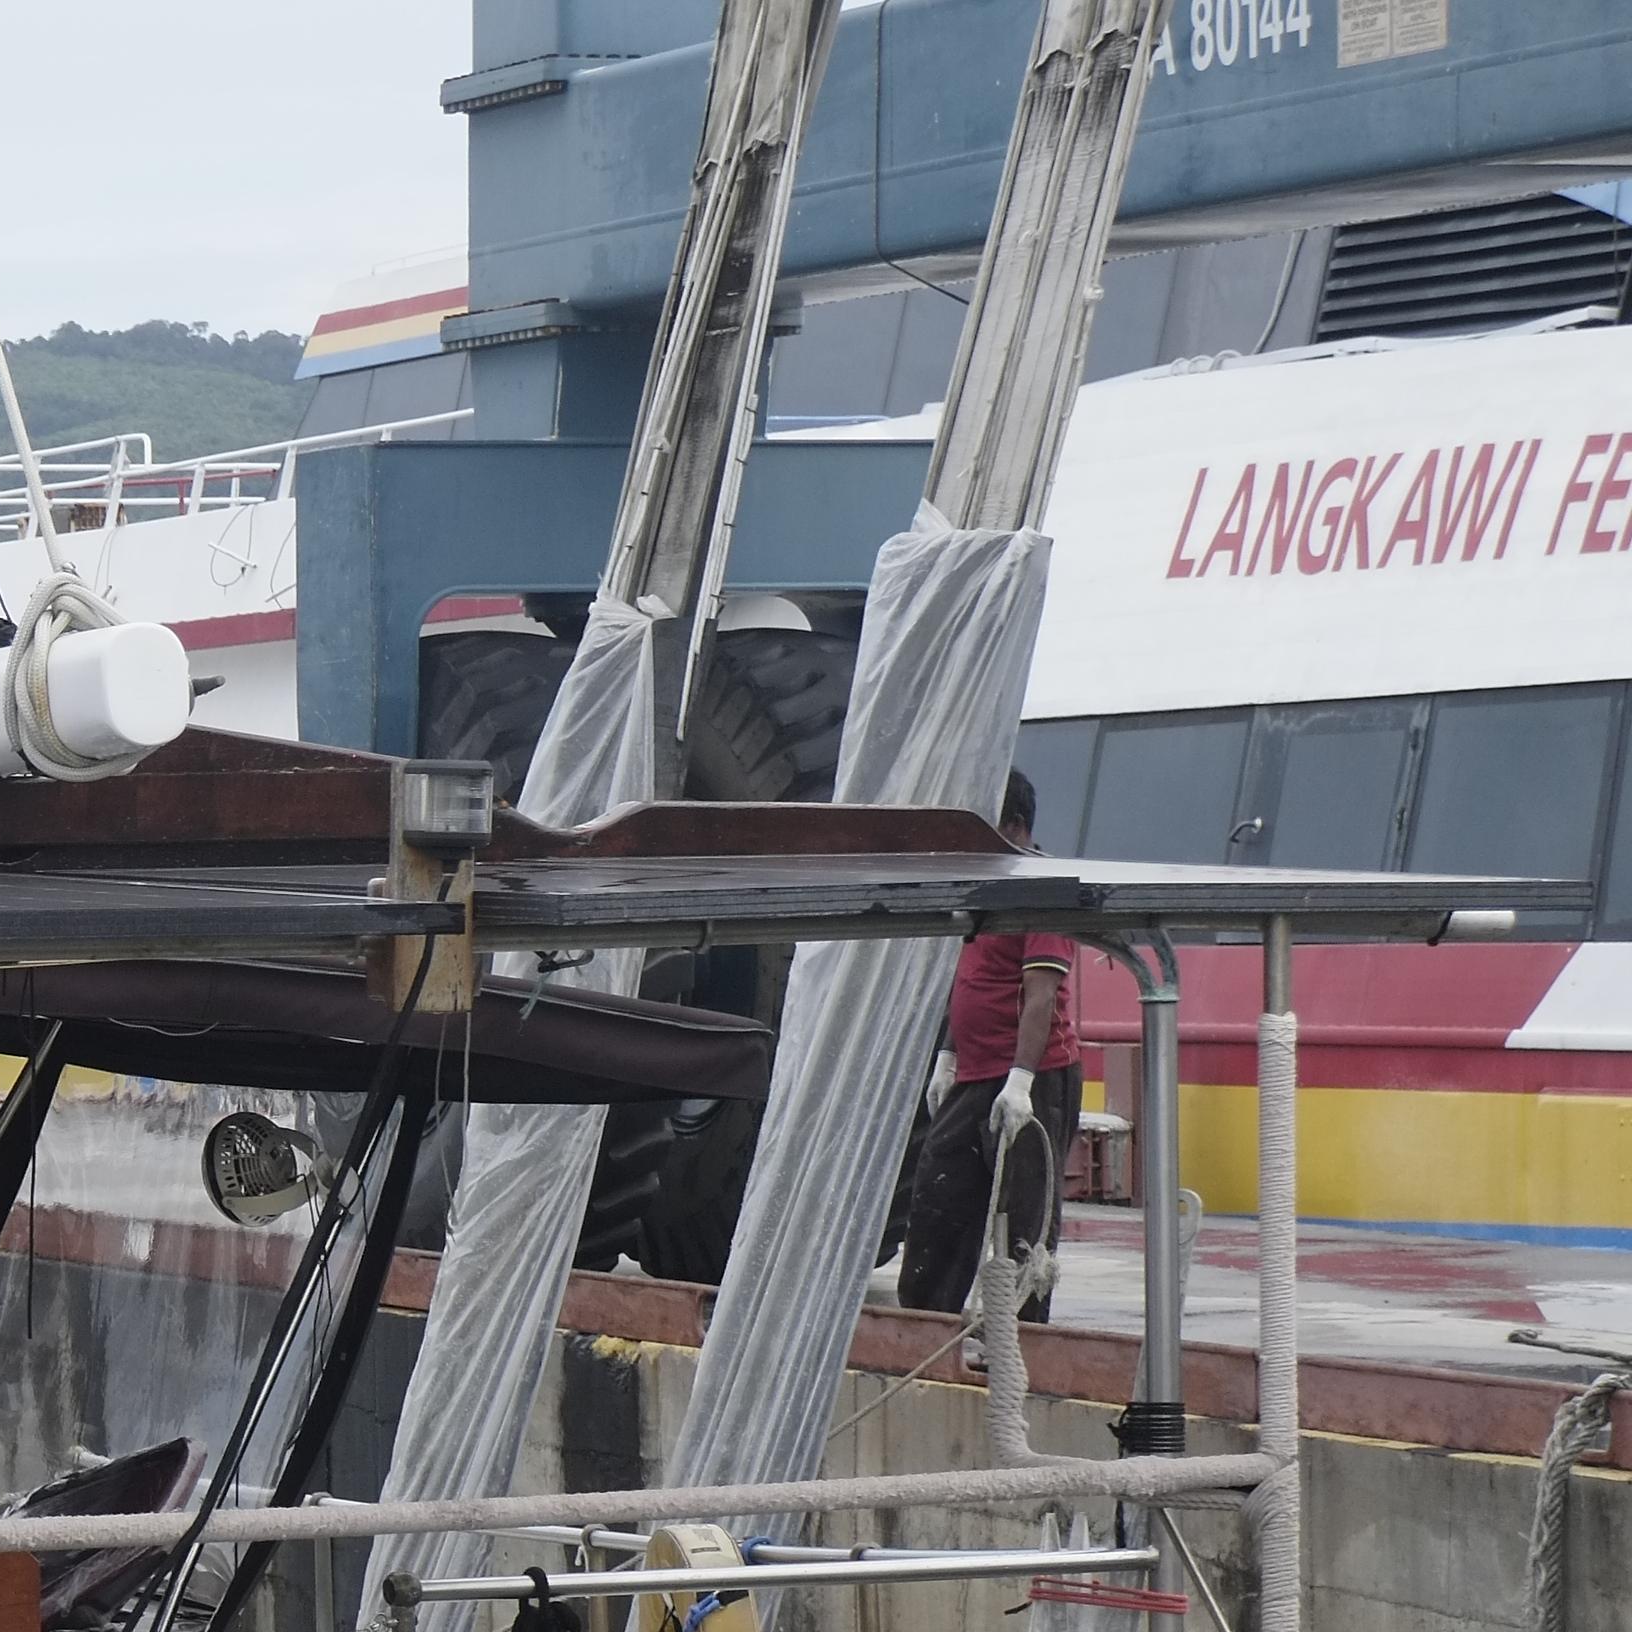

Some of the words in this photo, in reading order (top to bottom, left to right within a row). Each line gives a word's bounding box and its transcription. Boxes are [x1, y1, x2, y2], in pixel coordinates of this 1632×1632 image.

[1190, 0, 1311, 71] 80144
[1166, 438, 1543, 579] LANGKAWI
[1544, 432, 1632, 556] FE
